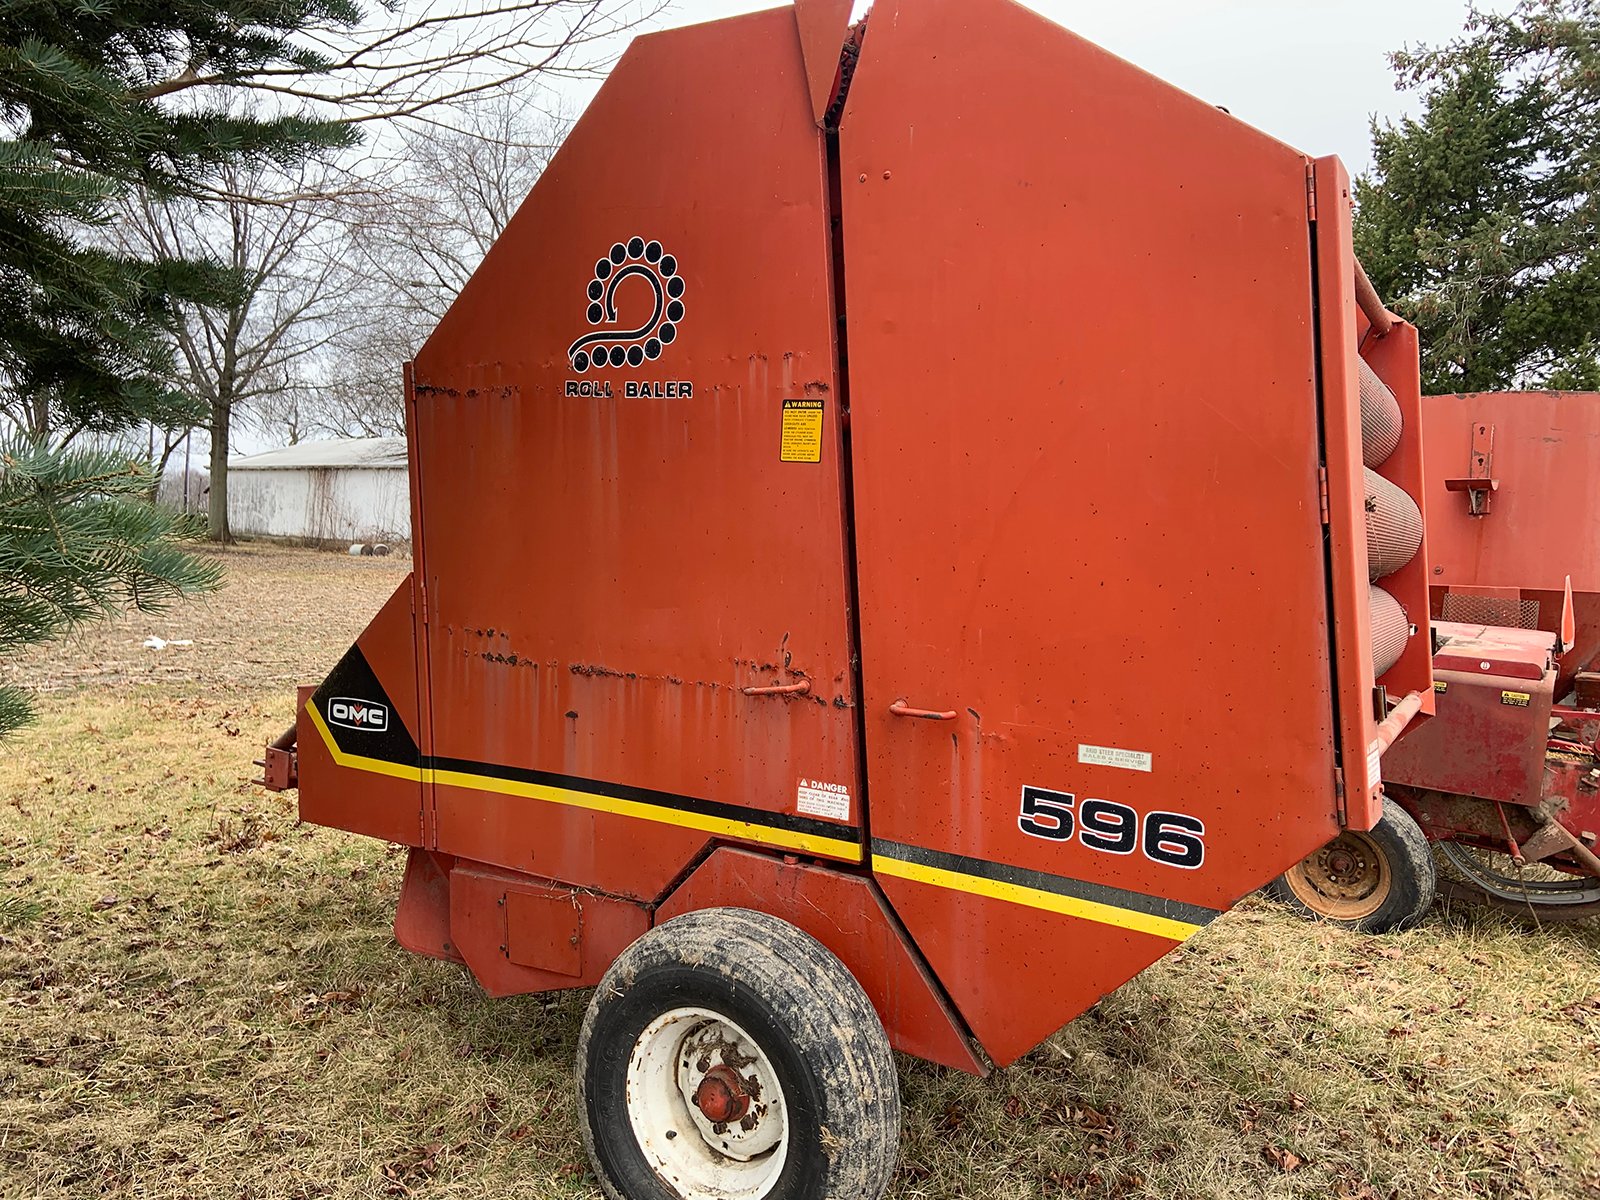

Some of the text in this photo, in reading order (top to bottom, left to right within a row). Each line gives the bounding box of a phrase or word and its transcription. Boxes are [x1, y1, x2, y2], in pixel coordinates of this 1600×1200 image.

[565, 380, 693, 399] ROLL BALER
[333, 703, 384, 725] OMC
[811, 780, 848, 794] DANGER
[1017, 784, 1205, 870] 596
